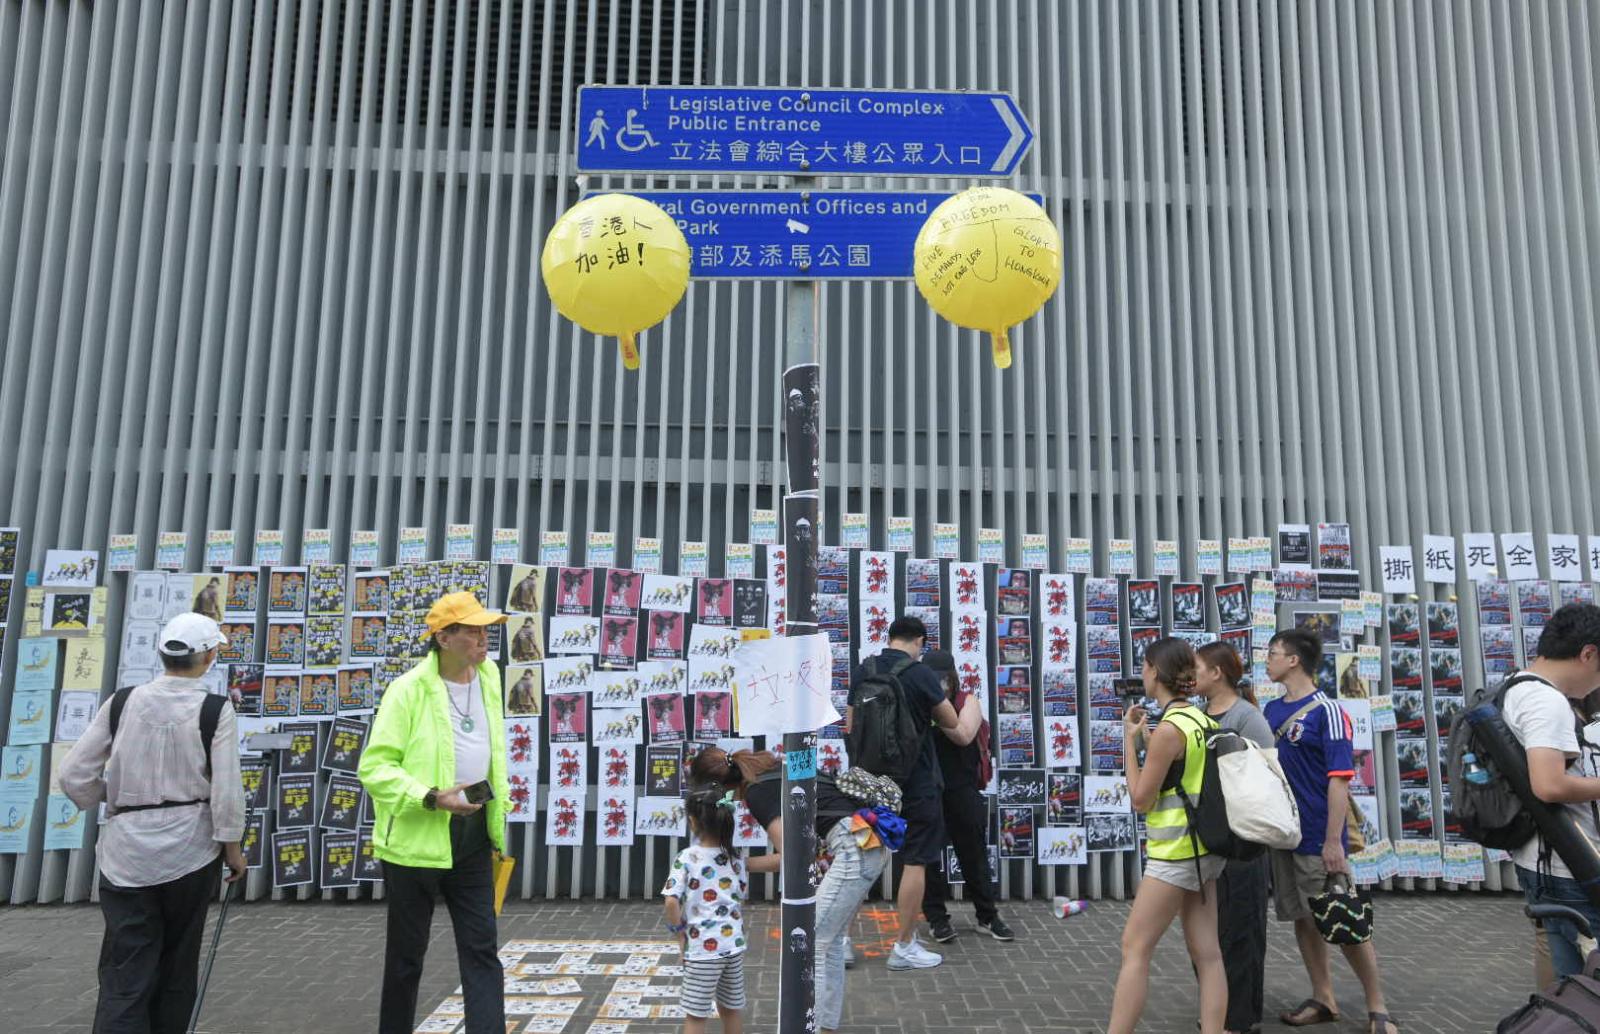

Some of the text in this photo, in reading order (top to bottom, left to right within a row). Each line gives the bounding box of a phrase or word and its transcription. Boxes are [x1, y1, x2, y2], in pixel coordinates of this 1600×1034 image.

[668, 96, 944, 117] Legislative Council Complex
[668, 115, 821, 131] Public Entrance
[668, 139, 982, 164] 立法會綜合大樓公眾入口
[690, 198, 810, 215] Government
[815, 198, 886, 215] Offices
[891, 199, 928, 215] and
[939, 203, 1009, 228] FREEDOM
[676, 219, 719, 235] Park
[921, 244, 944, 271] FIVE
[1019, 244, 1035, 259] TO
